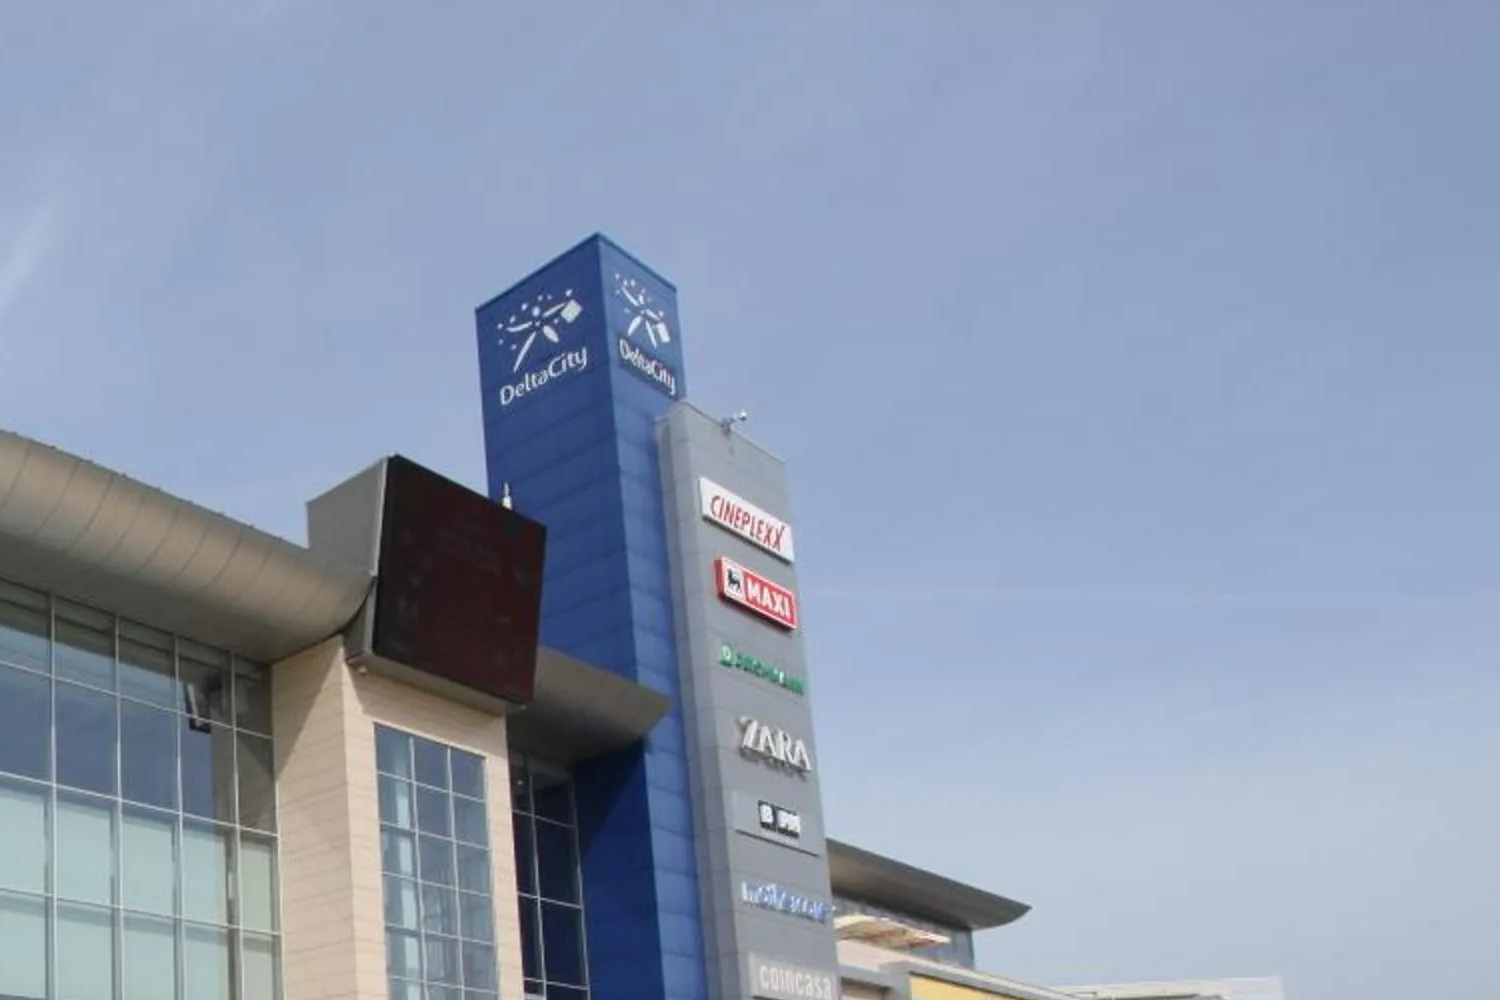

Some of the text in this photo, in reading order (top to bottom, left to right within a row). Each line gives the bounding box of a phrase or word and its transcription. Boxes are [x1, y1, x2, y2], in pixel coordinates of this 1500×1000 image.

[500, 345, 588, 406] DeltaCity
[619, 338, 677, 396] DeltaCity
[709, 494, 786, 552] CINEPLEXX
[744, 576, 791, 621] MAXI
[738, 716, 813, 771] ZARA
